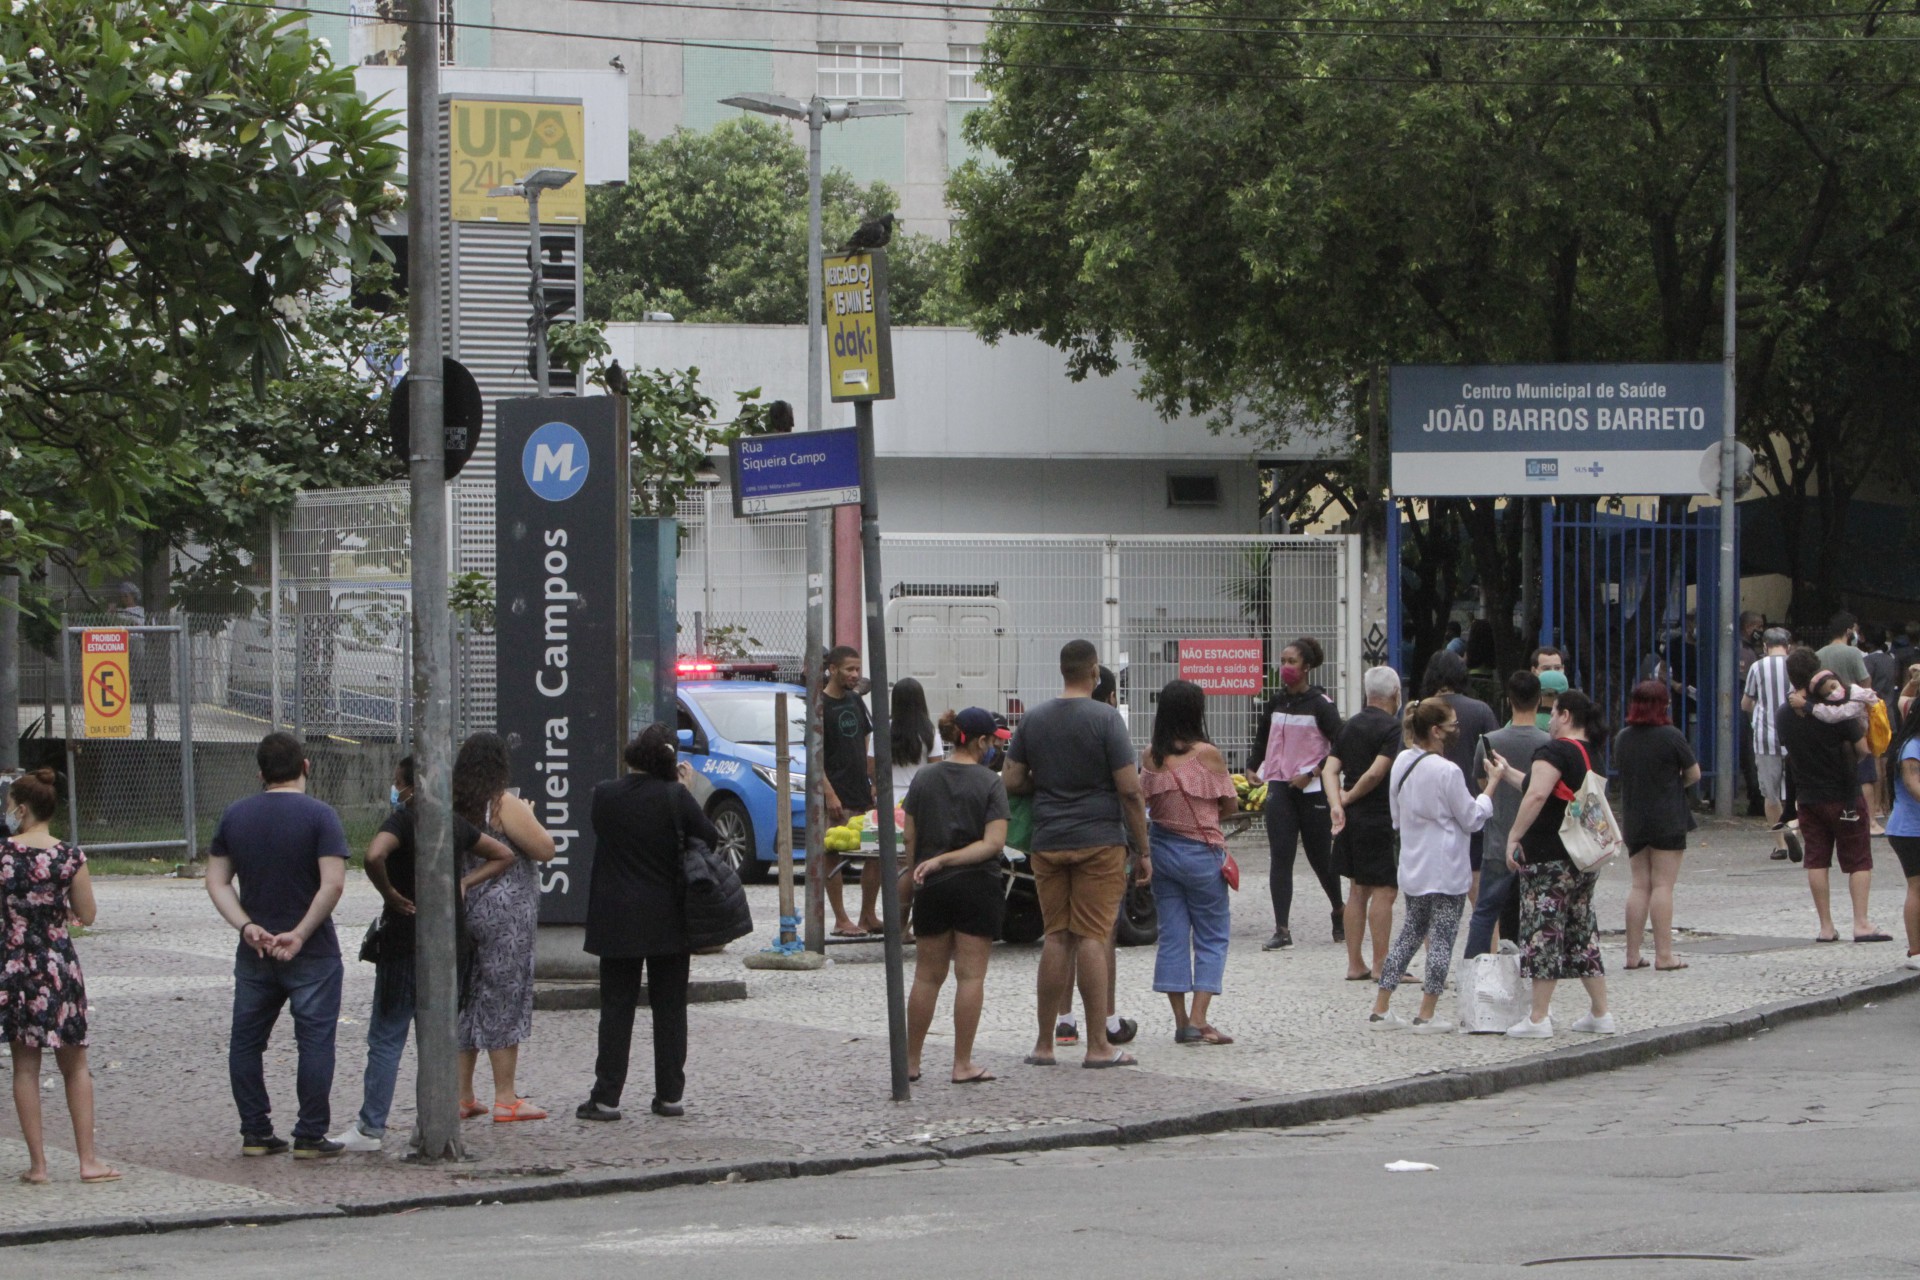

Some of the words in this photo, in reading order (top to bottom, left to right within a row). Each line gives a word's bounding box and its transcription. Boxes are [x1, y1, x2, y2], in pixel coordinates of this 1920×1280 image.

[458, 106, 576, 159] UPA
[825, 264, 871, 286] MERCADO
[833, 292, 846, 315] 15
[845, 290, 864, 315] MIN
[835, 319, 873, 363] daki
[1462, 382, 1511, 400] Centro
[1516, 382, 1591, 402] Municipal
[1596, 383, 1615, 399] de
[1619, 382, 1667, 398] Saúde
[1422, 404, 1484, 432] JOÃO
[1493, 408, 1590, 432] BARROS
[1597, 406, 1706, 430] BARRETO
[741, 442, 763, 454] Rua
[742, 456, 787, 472] Siqueira
[789, 452, 826, 466] Campo
[1541, 463, 1557, 472] RIO
[747, 499, 768, 512] 121
[840, 489, 858, 503] 129
[535, 528, 578, 698] Campos
[87, 643, 125, 653] ESTACIONAR
[91, 634, 121, 643] PROIBIDO
[1182, 648, 1202, 659] NÃO
[1204, 649, 1260, 659] ESTACIONE!
[1182, 664, 1214, 673] entrada
[1216, 665, 1222, 673] e
[1224, 664, 1246, 673] saída
[1248, 664, 1259, 673] de
[90, 726, 102, 734] DIA
[103, 725, 107, 733] E
[108, 725, 127, 734] NOITE
[702, 759, 740, 775] 54-0294
[534, 716, 579, 894] Siqueira
